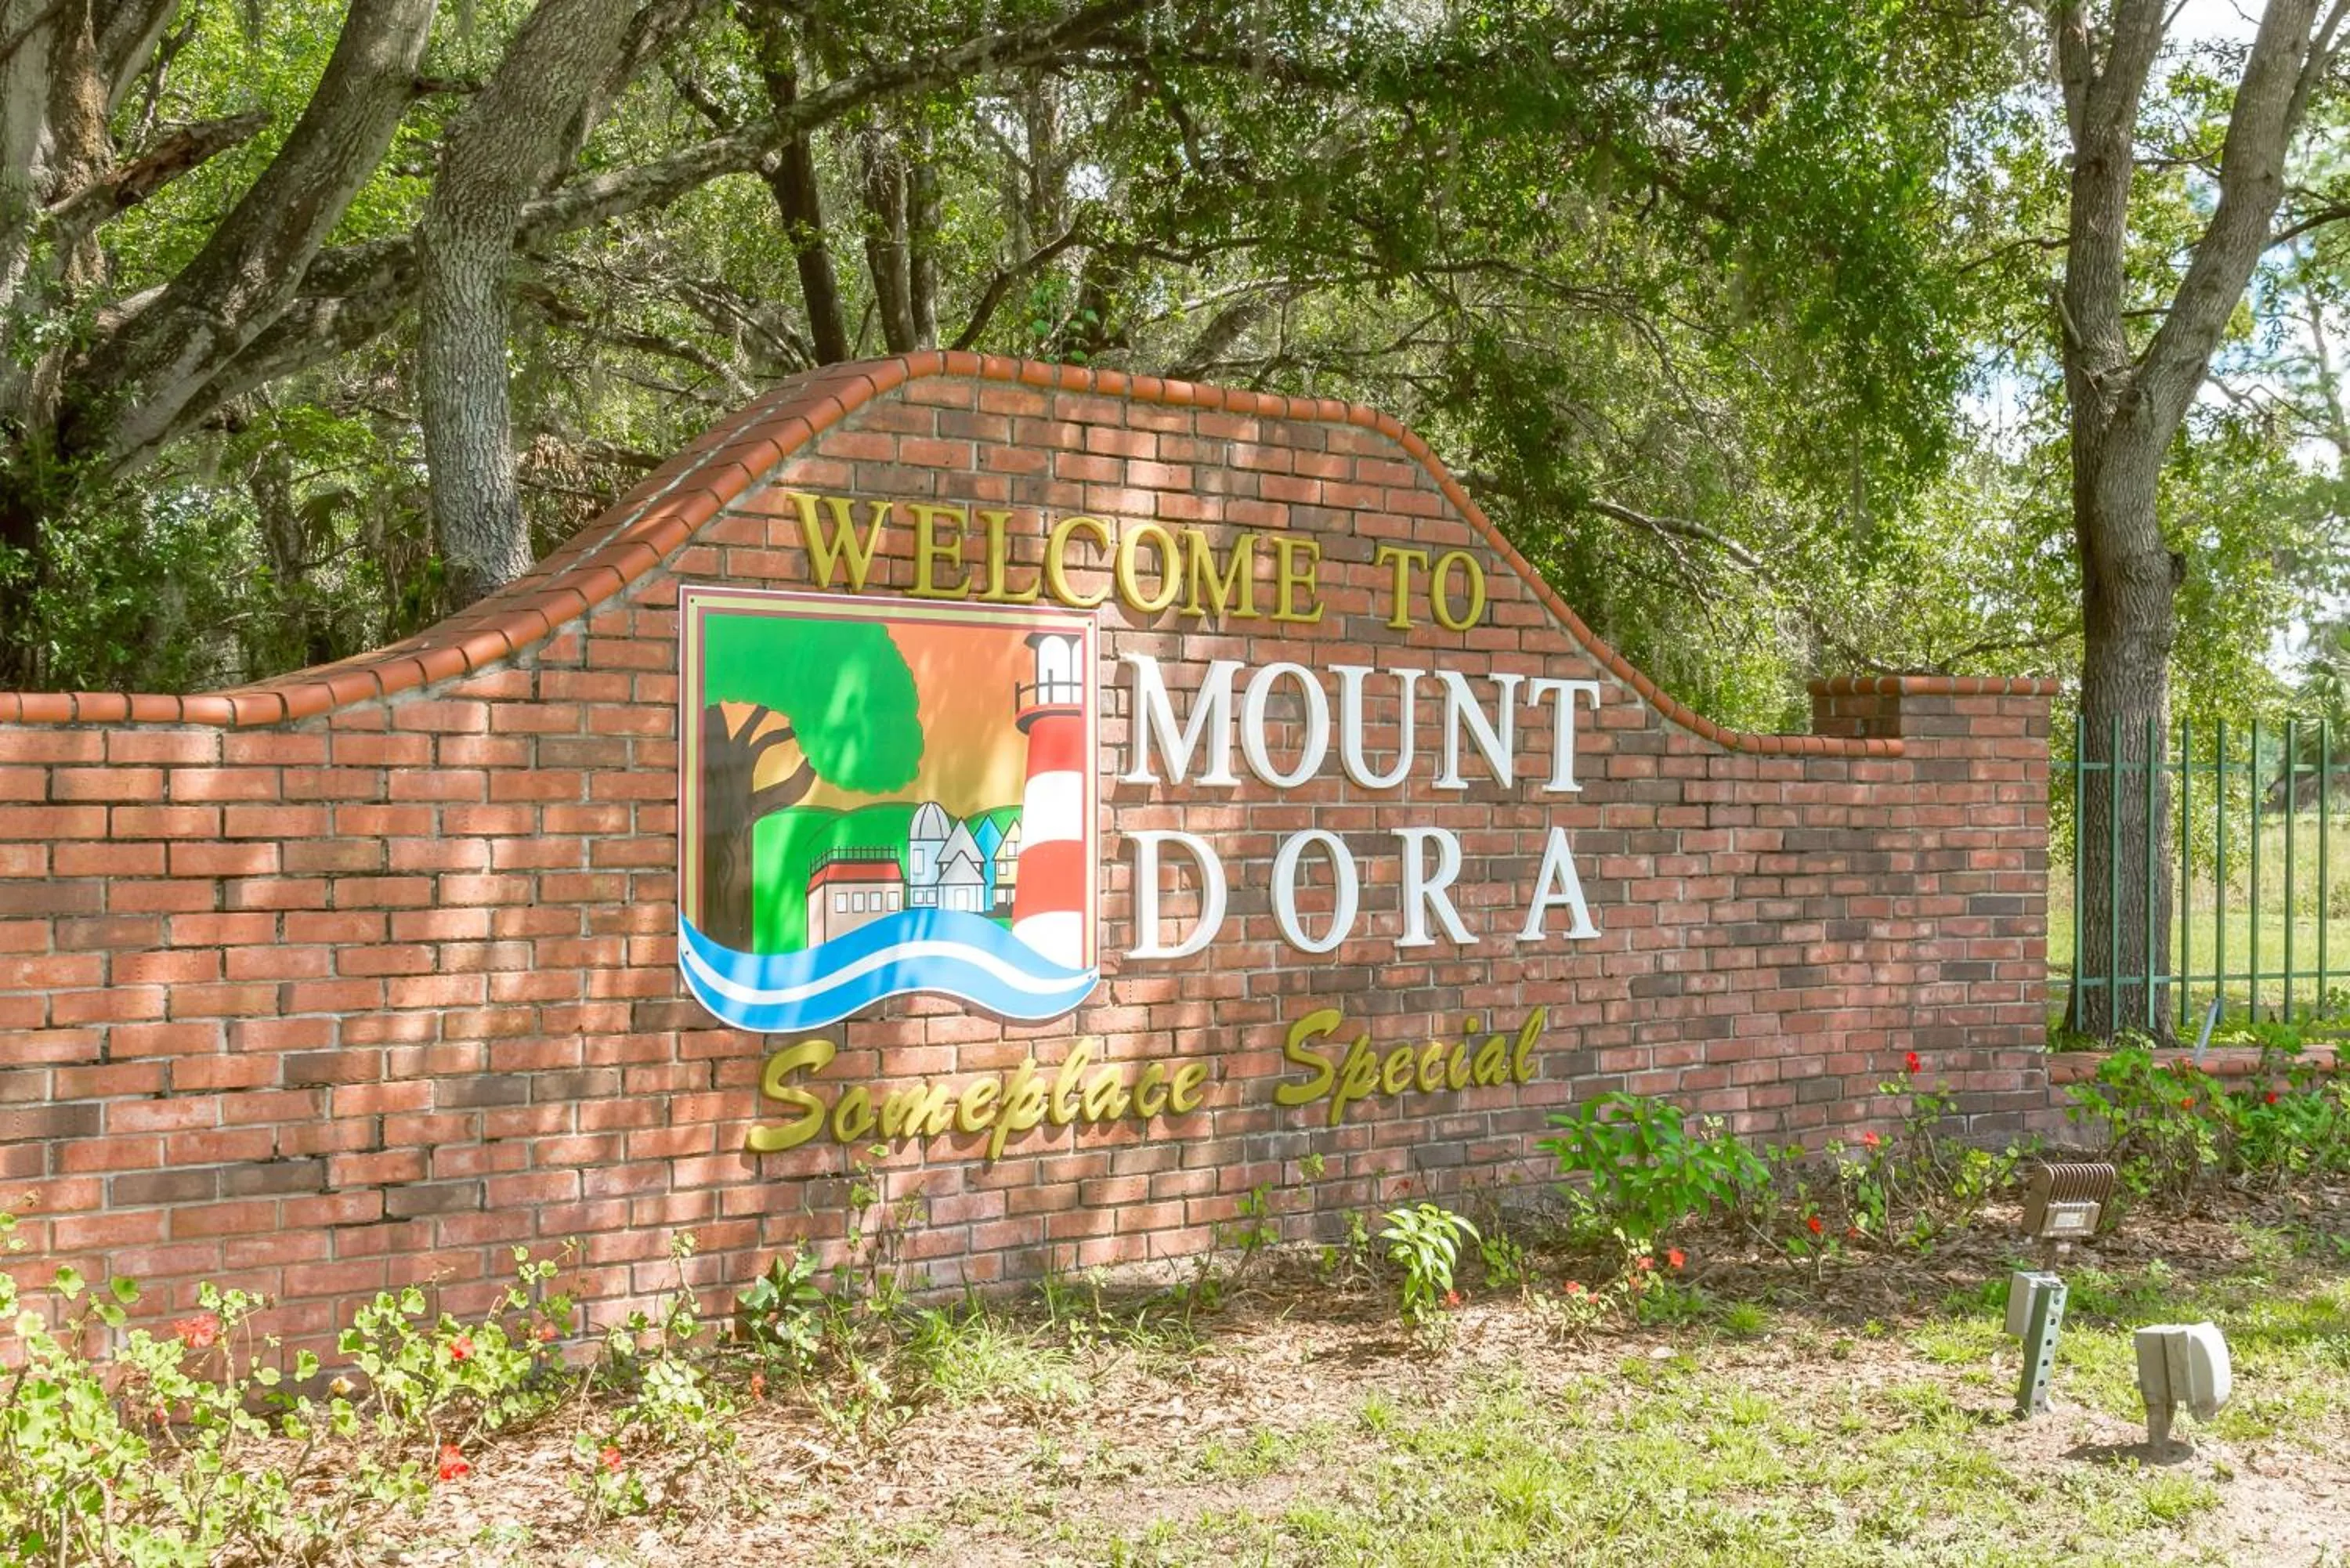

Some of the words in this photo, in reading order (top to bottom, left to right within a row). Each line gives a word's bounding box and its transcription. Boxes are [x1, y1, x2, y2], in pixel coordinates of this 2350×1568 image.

[788, 493, 1325, 624] WELCOME
[1374, 546, 1488, 631] TO
[1121, 652, 1601, 793] MOUNT
[1121, 826, 1601, 961] DORA
[746, 1037, 1209, 1161] Someplace
[1274, 1006, 1549, 1126] Special
